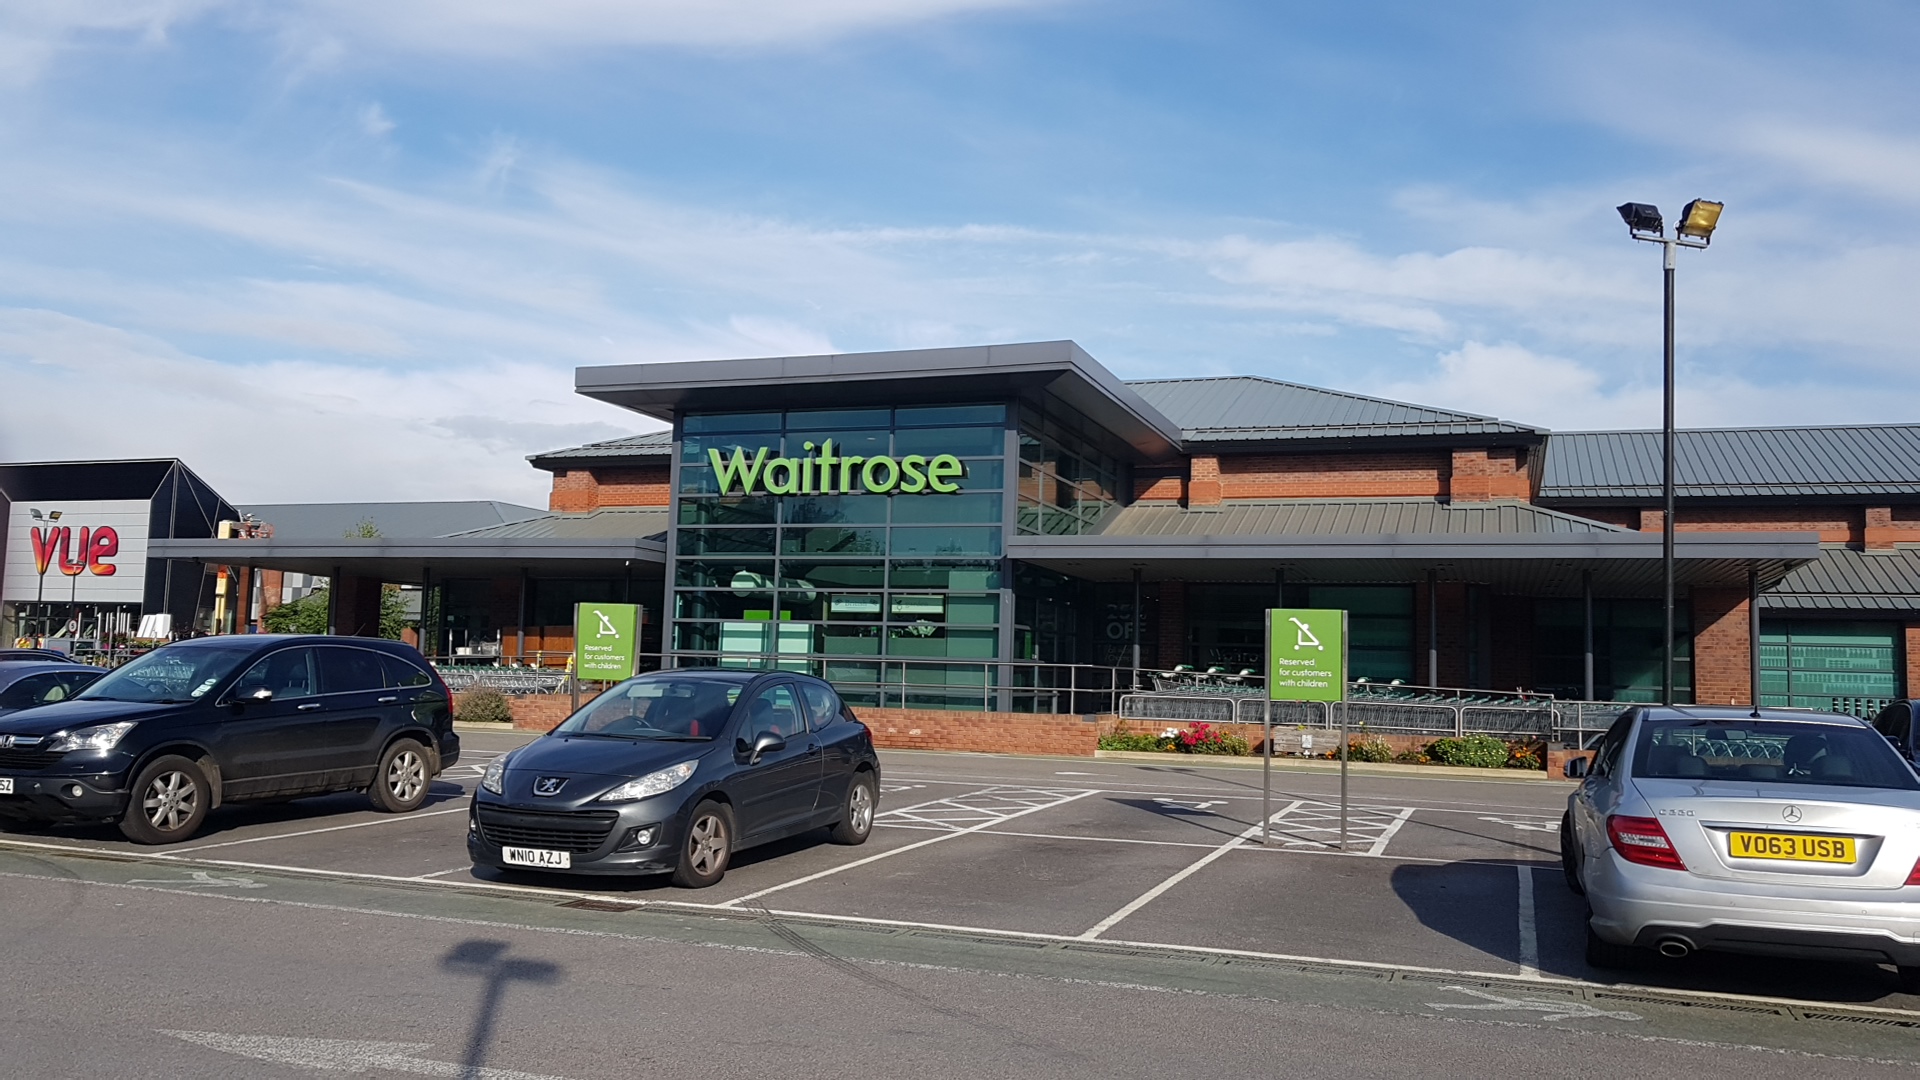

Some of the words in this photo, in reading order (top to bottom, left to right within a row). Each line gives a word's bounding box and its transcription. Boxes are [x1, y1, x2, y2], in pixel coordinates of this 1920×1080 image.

[707, 437, 966, 496] Waitrose
[584, 644, 613, 652] Reserved
[584, 652, 593, 660] for
[594, 653, 625, 661] customers
[1279, 657, 1315, 666] Reserved
[597, 662, 622, 670] children
[1279, 667, 1291, 677] for
[1291, 668, 1332, 678] customers
[1279, 678, 1296, 688] with
[1296, 679, 1329, 688] children
[1740, 835, 1796, 855] VO63
[1802, 838, 1846, 859] USB
[508, 848, 536, 863] WN10
[538, 850, 562, 865] AZJ
